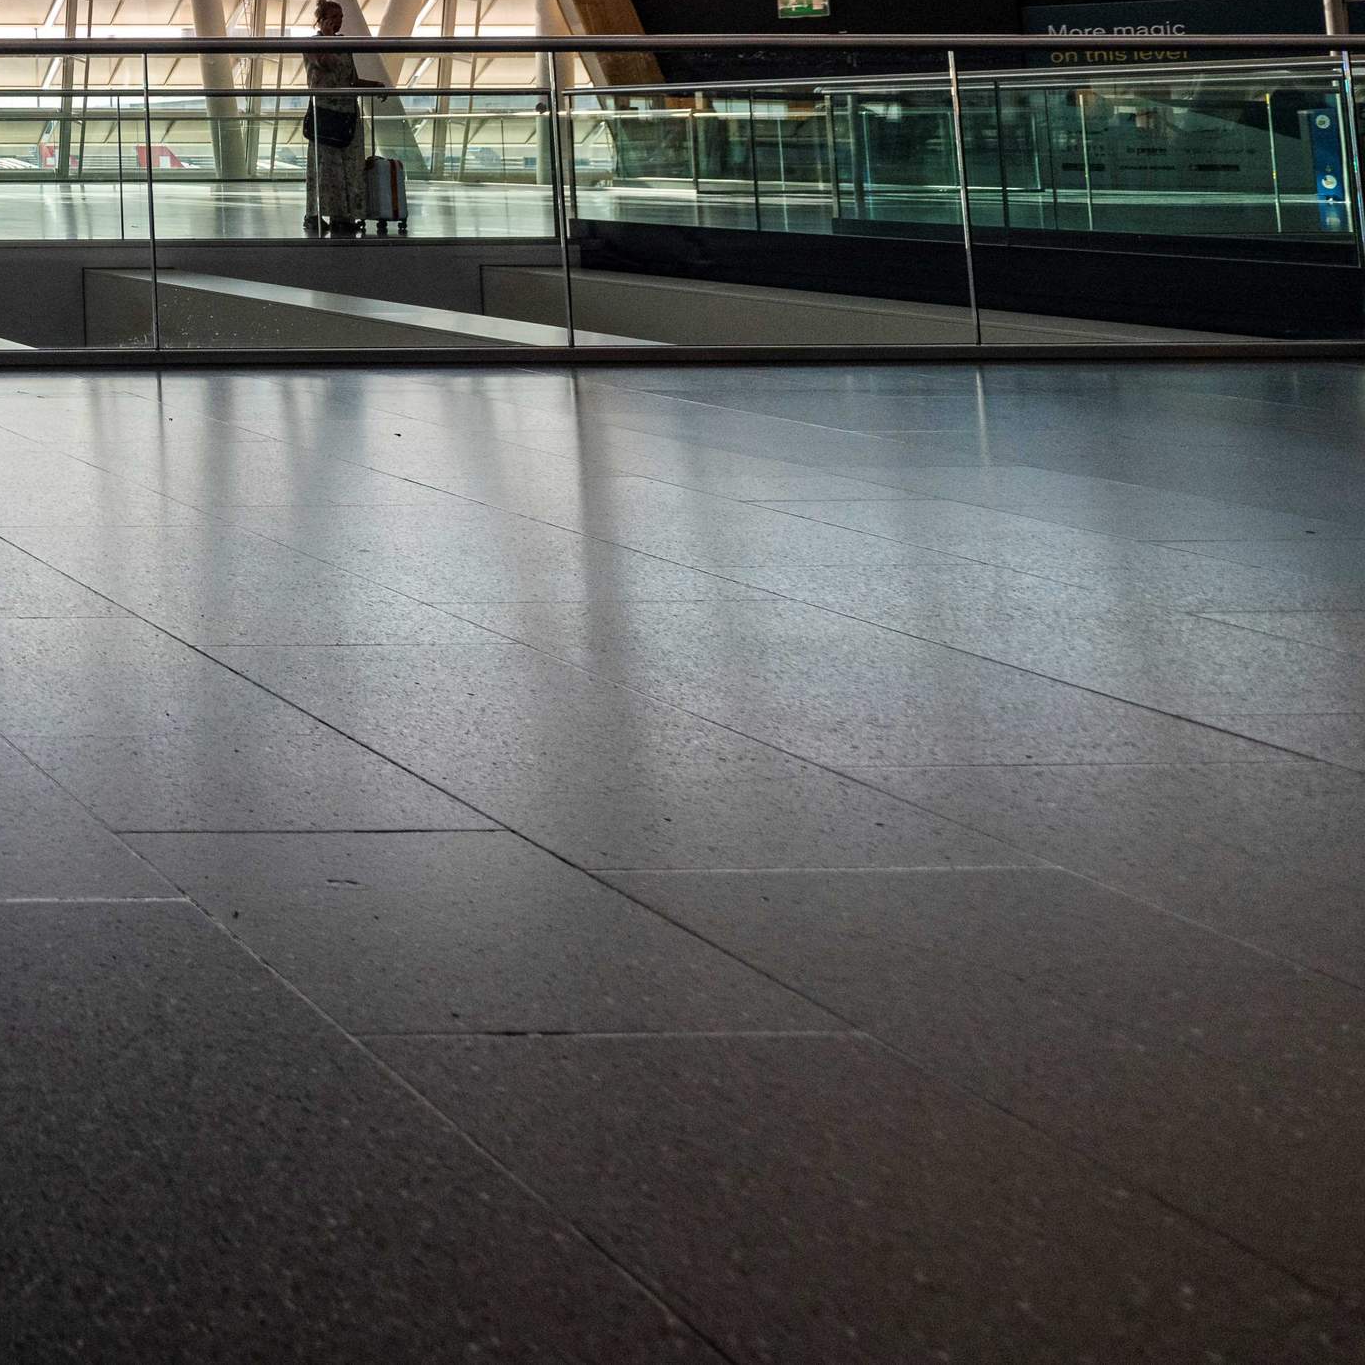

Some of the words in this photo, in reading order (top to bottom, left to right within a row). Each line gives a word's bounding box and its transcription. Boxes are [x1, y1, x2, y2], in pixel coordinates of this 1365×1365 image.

[1048, 24, 1107, 36] More
[1113, 21, 1188, 36] magic
[1050, 51, 1079, 64] on
[1086, 50, 1128, 63] this
